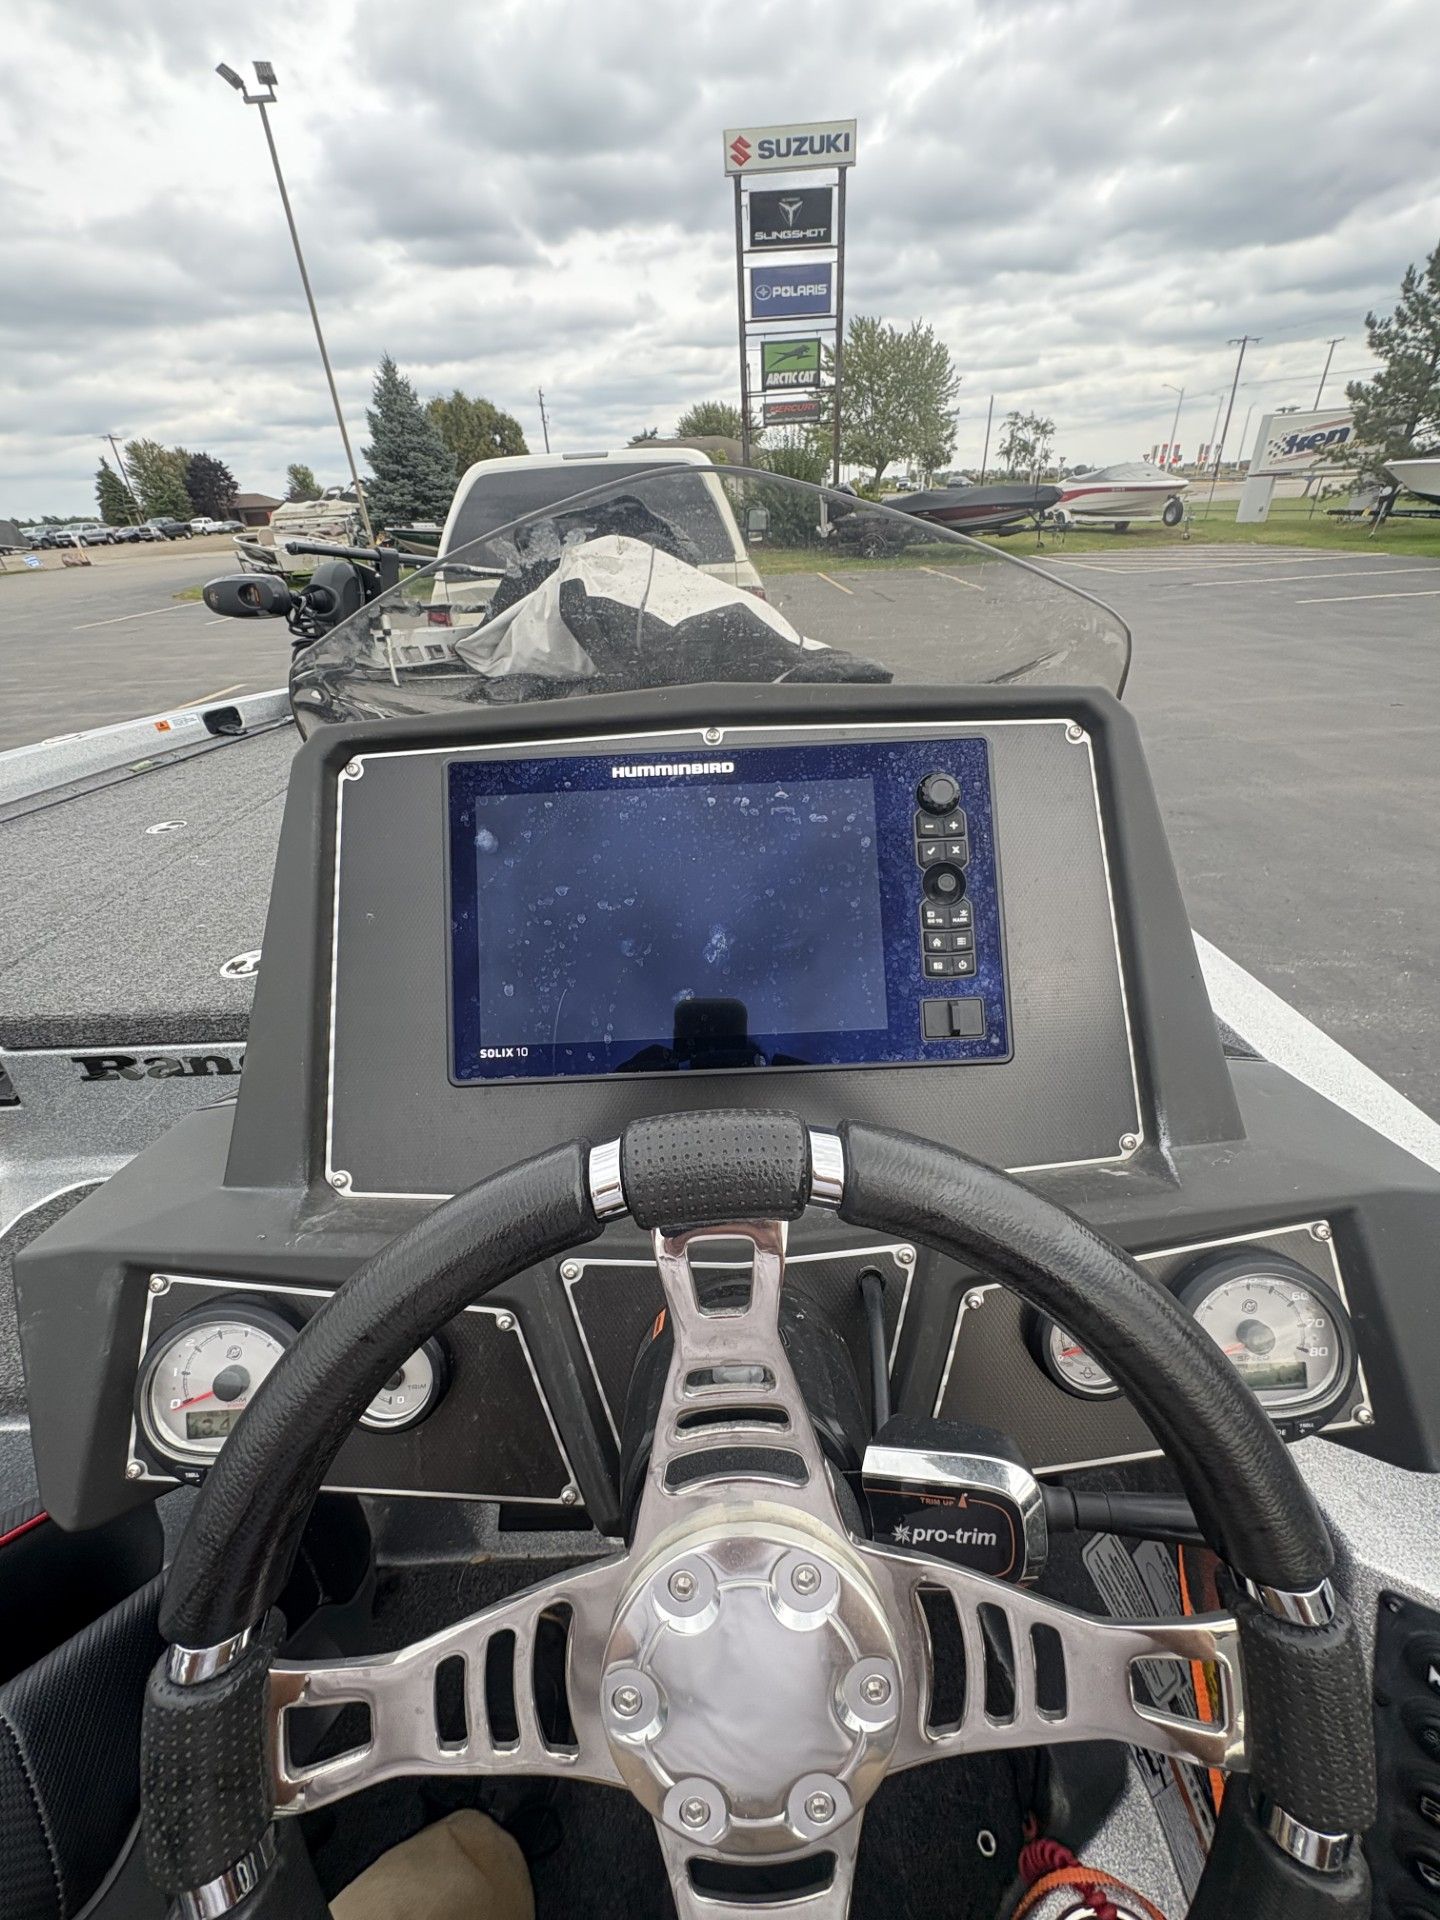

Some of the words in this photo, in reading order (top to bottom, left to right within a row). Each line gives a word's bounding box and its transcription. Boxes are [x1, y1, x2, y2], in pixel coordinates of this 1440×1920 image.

[757, 133, 850, 160] SUZUKI
[754, 228, 827, 240] SLINGSHOT
[772, 283, 828, 298] POLARIS
[766, 372, 797, 386] ARCTIC
[798, 371, 817, 384] CAT
[612, 762, 735, 778] HUMMINBIRD
[480, 1048, 514, 1059] SOLIX
[516, 1047, 529, 1057] 10
[71, 1055, 244, 1082] Ran
[1304, 1318, 1325, 1328] 70
[1309, 1347, 1329, 1357] 80
[407, 1383, 427, 1391] TRIM
[170, 1399, 181, 1410] 0
[397, 1396, 405, 1404] 0
[919, 1497, 941, 1506] TRIM
[911, 1527, 997, 1547] pro-trim
